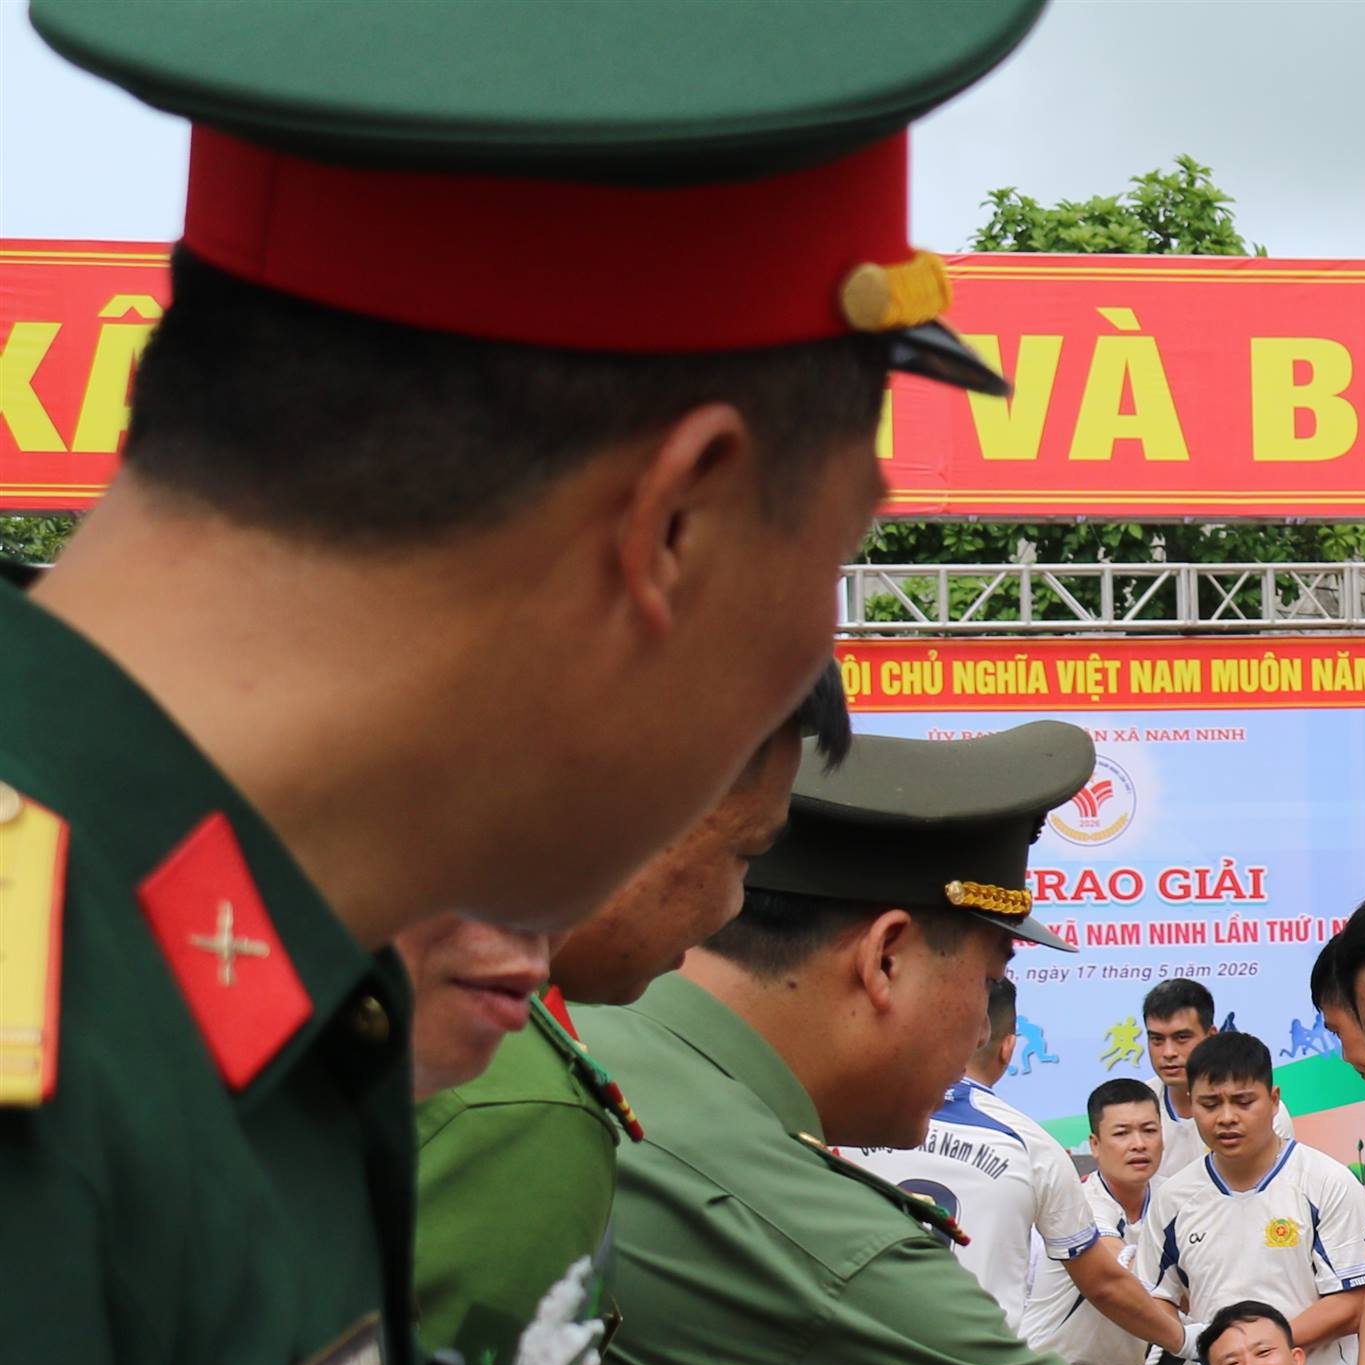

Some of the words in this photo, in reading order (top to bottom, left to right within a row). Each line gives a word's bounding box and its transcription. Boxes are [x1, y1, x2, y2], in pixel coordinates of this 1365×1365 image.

[959, 308, 1189, 460] VÀ
[841, 654, 871, 703] ỘI
[881, 649, 943, 695] CHỦ
[953, 653, 1049, 695] NGHĨA
[1056, 653, 1121, 701] VIỆT
[1131, 658, 1201, 694] NAM
[1211, 652, 1302, 693] MUÔN
[1114, 727, 1140, 742] XÃ
[1145, 728, 1191, 742] NAM
[1196, 728, 1245, 741] NINH
[1025, 869, 1145, 901] RAO
[1158, 859, 1266, 901] GIẢI
[1086, 923, 1141, 946] NAM
[1149, 921, 1206, 945] NINH
[1214, 915, 1259, 944] LẦN
[1266, 914, 1312, 943] THỨ
[1026, 965, 1070, 983] ngày
[1077, 965, 1096, 980] 17
[1102, 963, 1152, 982] tháng
[1158, 964, 1168, 978] 5
[1174, 964, 1212, 979] năm
[1217, 961, 1259, 977] 2026
[939, 1131, 973, 1163] Nam
[971, 1143, 1009, 1181] Ninh
